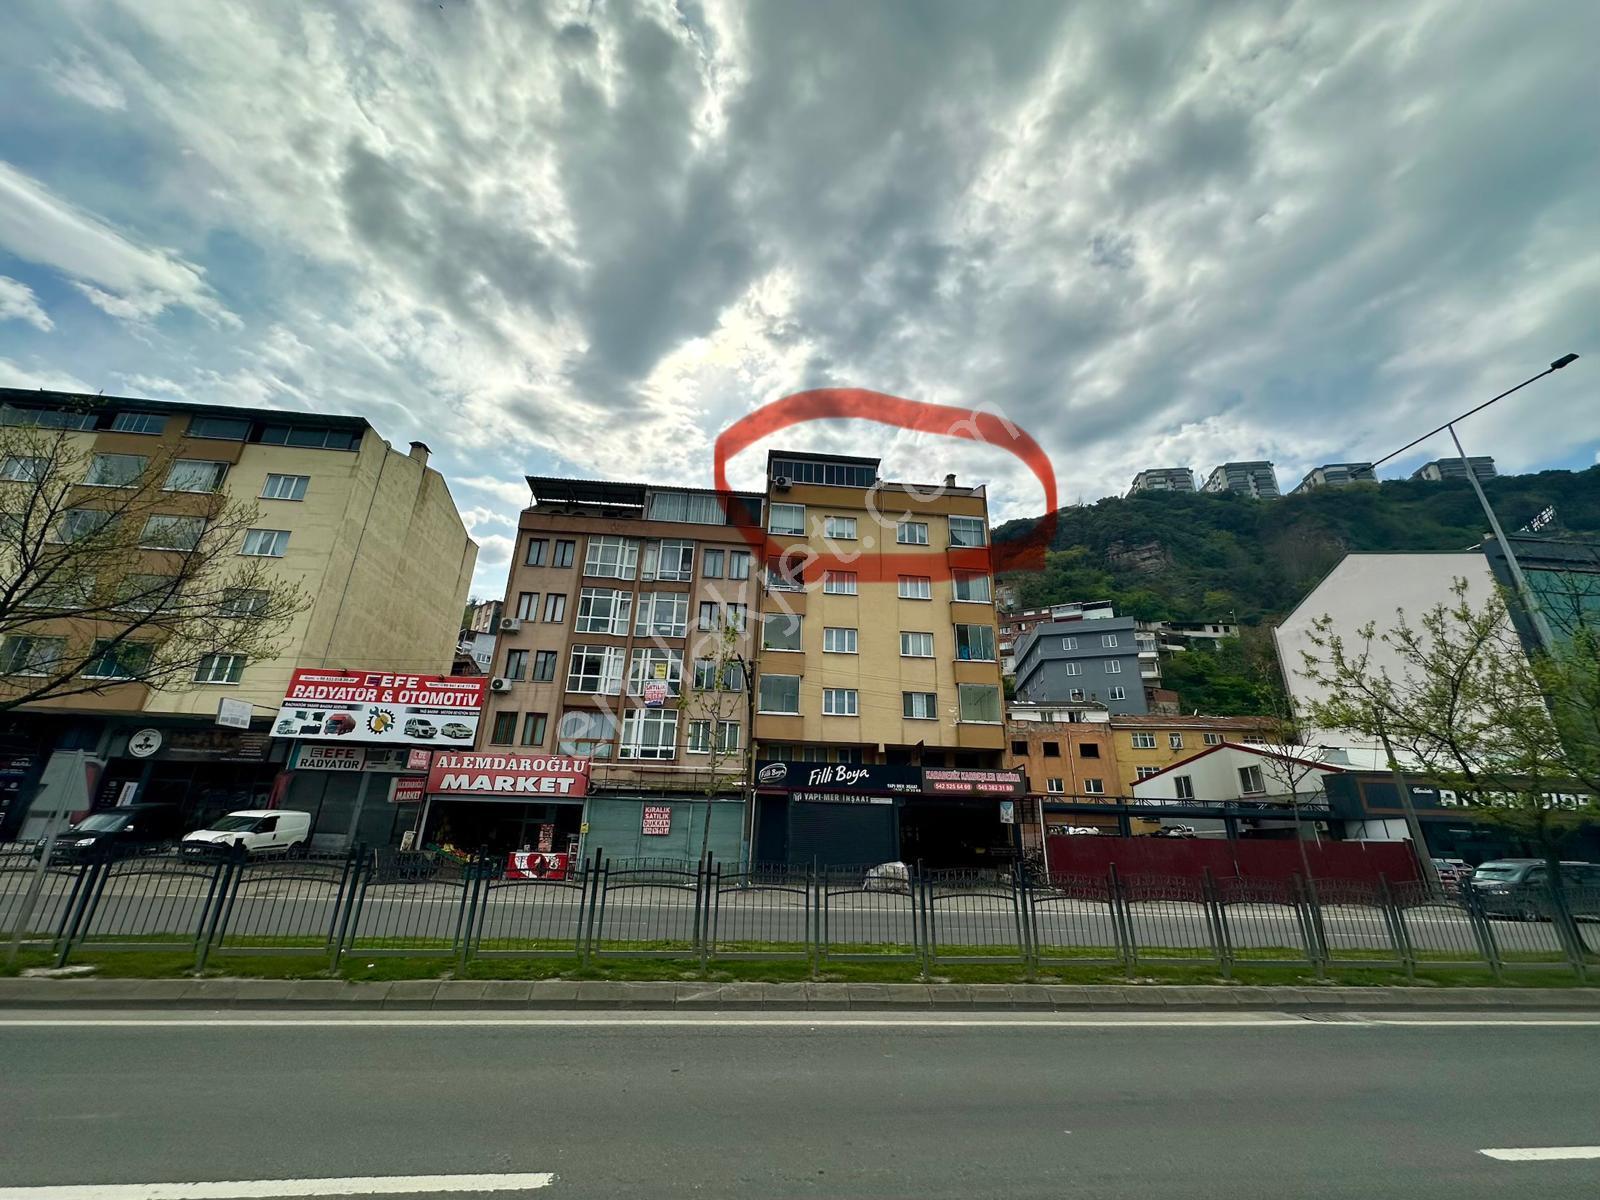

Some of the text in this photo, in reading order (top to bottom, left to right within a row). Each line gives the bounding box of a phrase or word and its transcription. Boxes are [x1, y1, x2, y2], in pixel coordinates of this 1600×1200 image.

[380, 675, 419, 689] EFE
[382, 689, 393, 702] &
[324, 748, 355, 759] EFE
[437, 755, 586, 772] ALEMDAROĞLU
[808, 765, 870, 785] Filli Boya
[440, 774, 575, 793] MARKET
[395, 791, 421, 801] MARKET
[804, 792, 840, 801] YAPI-MER
